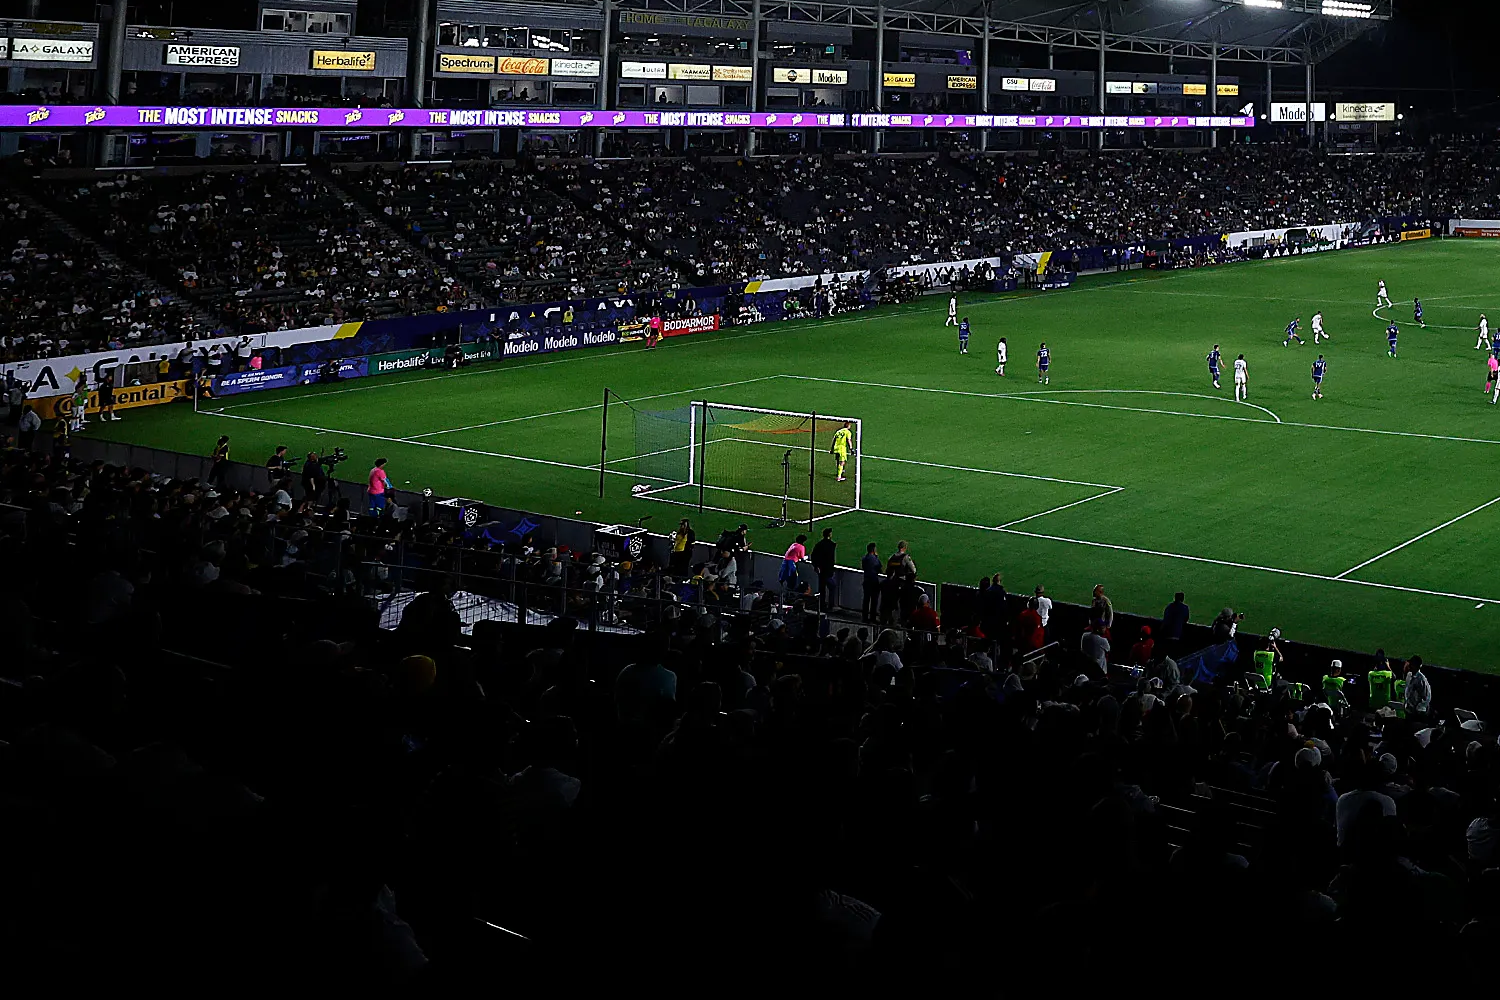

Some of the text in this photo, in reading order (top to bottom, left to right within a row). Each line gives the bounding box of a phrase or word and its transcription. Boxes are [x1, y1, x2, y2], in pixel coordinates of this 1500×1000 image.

[13, 44, 29, 52] LA
[42, 45, 92, 55] GALAXY
[169, 46, 237, 57] AMERICAN
[178, 56, 238, 65] EXPRESS
[317, 55, 366, 67] Herbalife
[441, 57, 490, 69] Spectrum
[554, 61, 583, 69] kinecta
[818, 72, 842, 83] Modelo
[1279, 107, 1314, 120] Modeo
[1343, 104, 1373, 113] kinecta
[26, 107, 51, 125] Takis
[84, 107, 106, 125] Takis
[138, 108, 319, 125] THE MOST INTENSE SNACKS
[429, 110, 560, 125] THE MOST INTENSE SNACKS
[644, 112, 751, 125] THE MOST INTENSE SNACKS
[664, 316, 714, 331] BODYARMOR
[503, 340, 539, 355] Modelo
[544, 335, 578, 350] Modelo
[583, 330, 616, 344] Modelo
[464, 352, 479, 360] best
[378, 356, 425, 371] Herbalife
[221, 379, 231, 387] BE
[237, 376, 260, 385] SPERM
